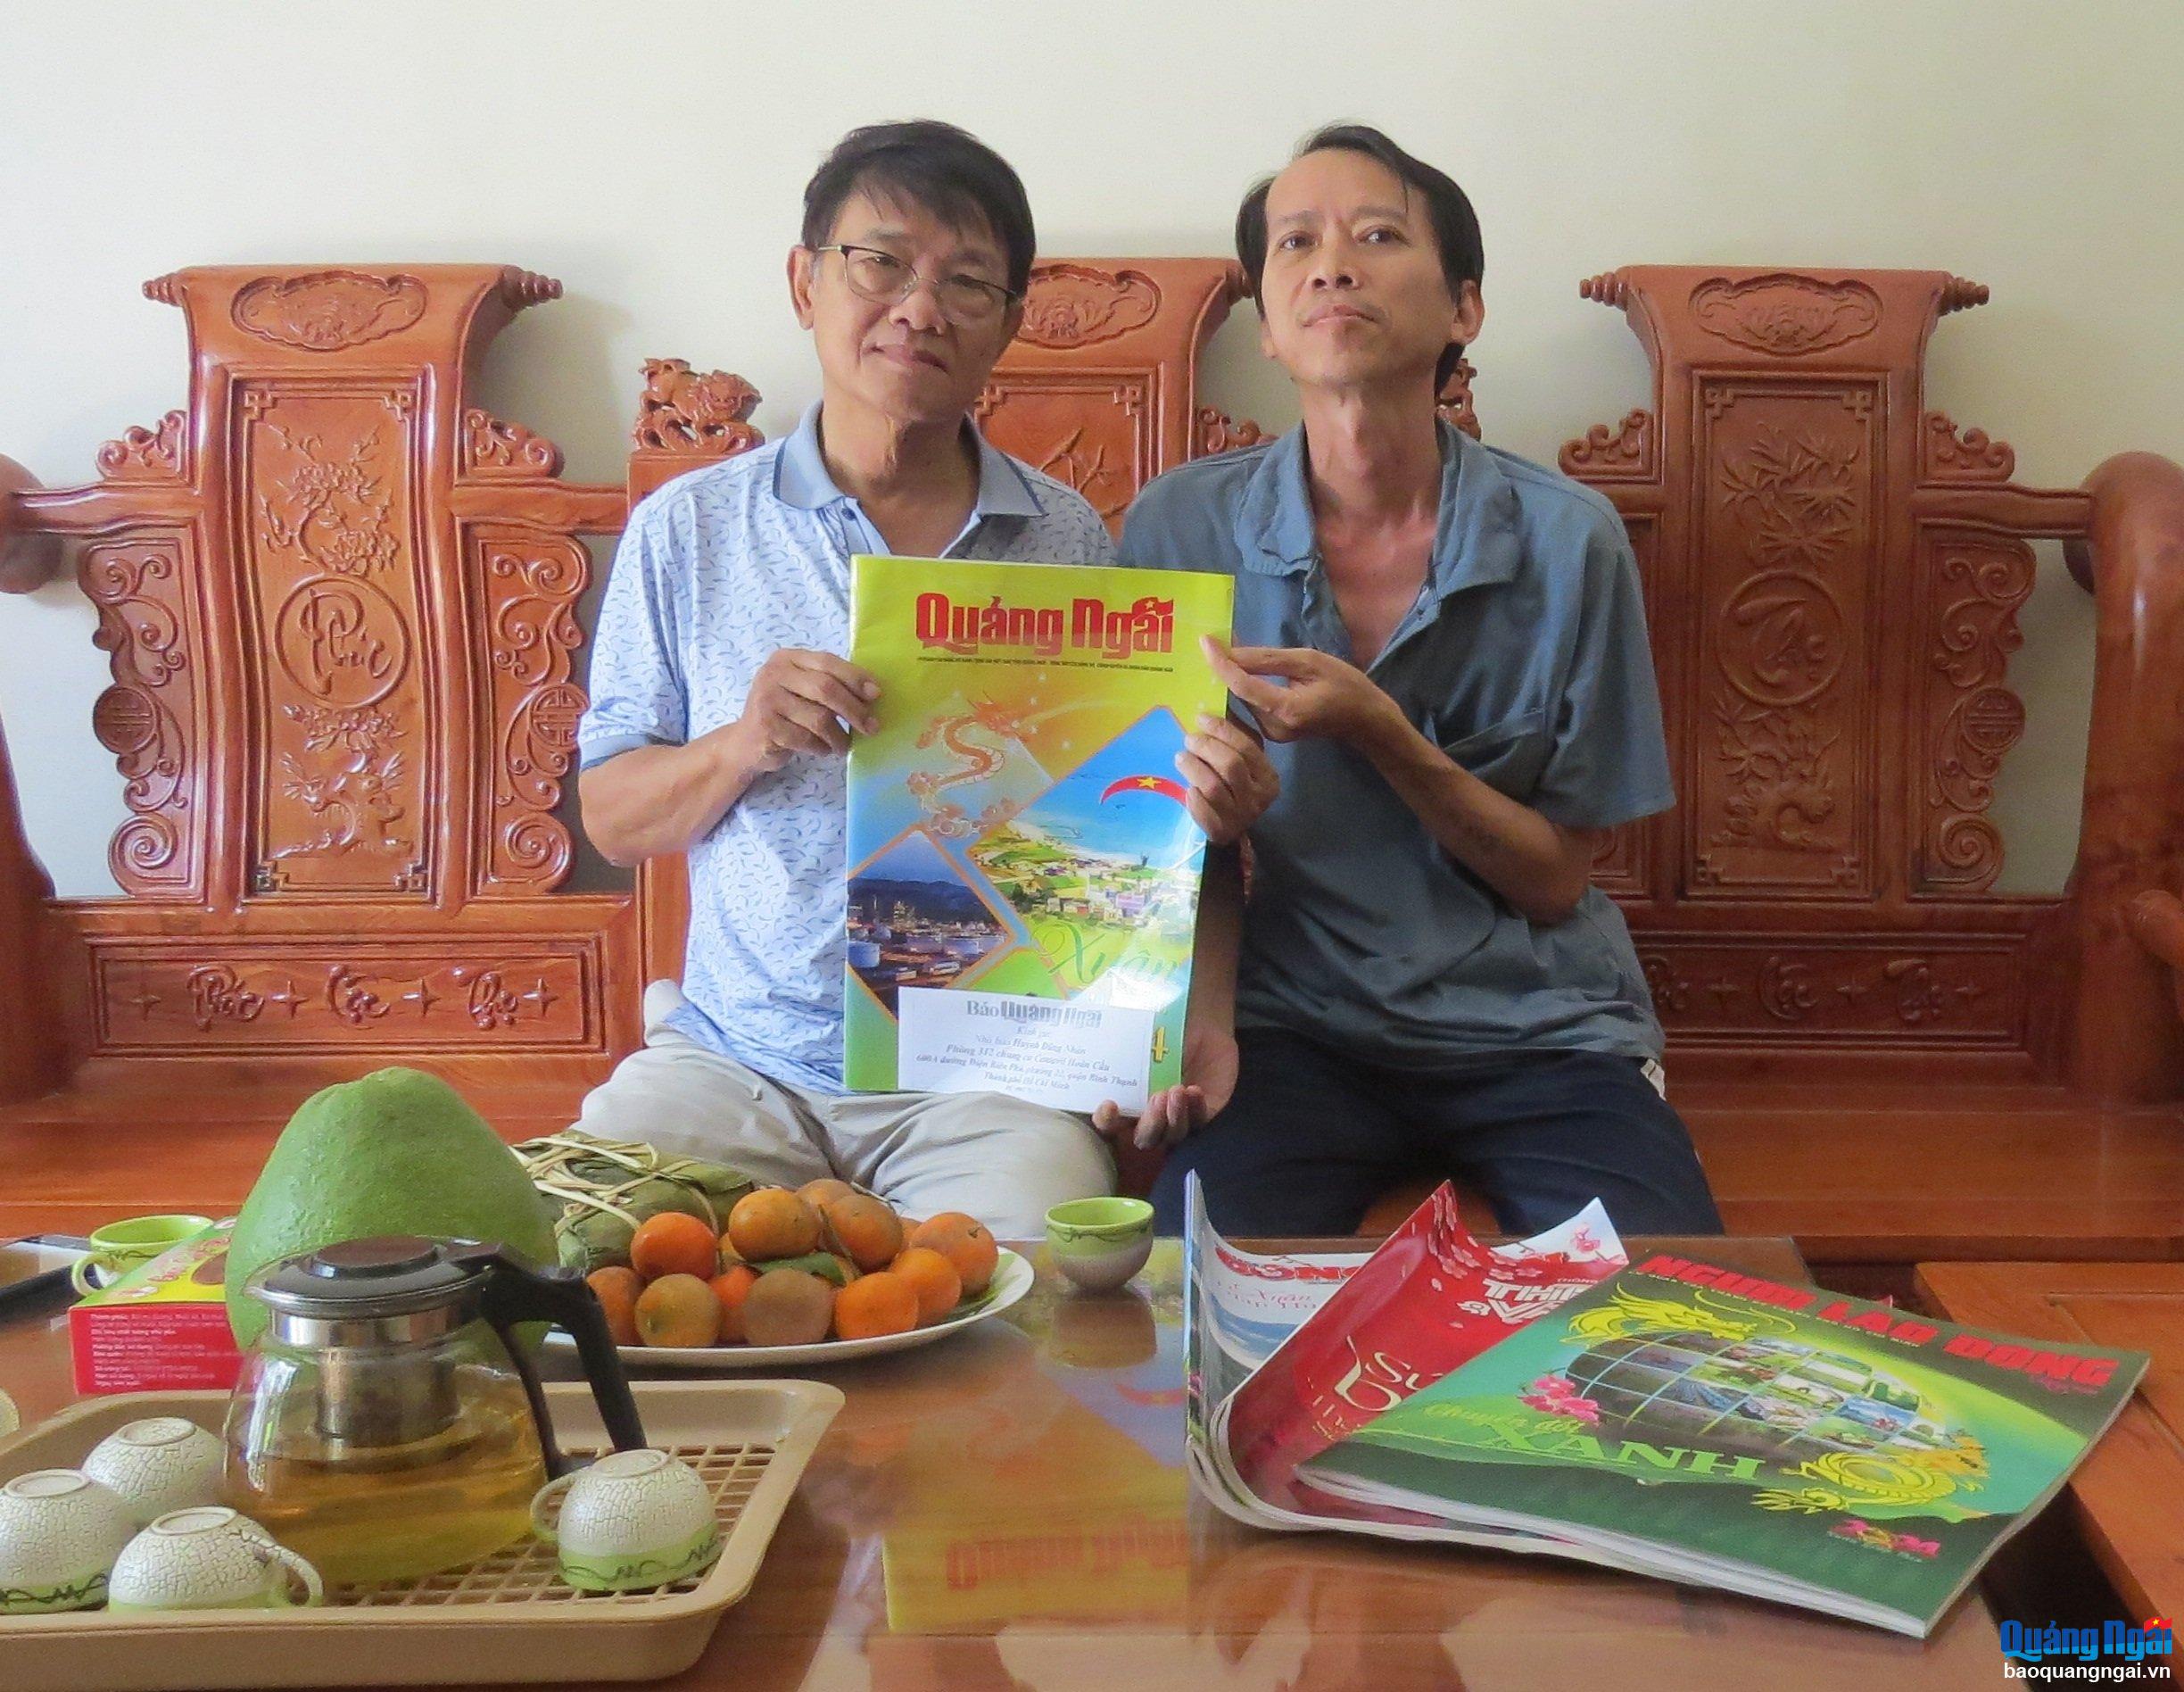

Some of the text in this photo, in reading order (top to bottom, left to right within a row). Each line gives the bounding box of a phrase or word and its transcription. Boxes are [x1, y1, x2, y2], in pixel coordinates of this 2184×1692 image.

[915, 593, 1174, 659] Quảng Ngãi
[966, 999, 999, 1017] Báo
[1477, 1422, 1766, 1480] XANH
